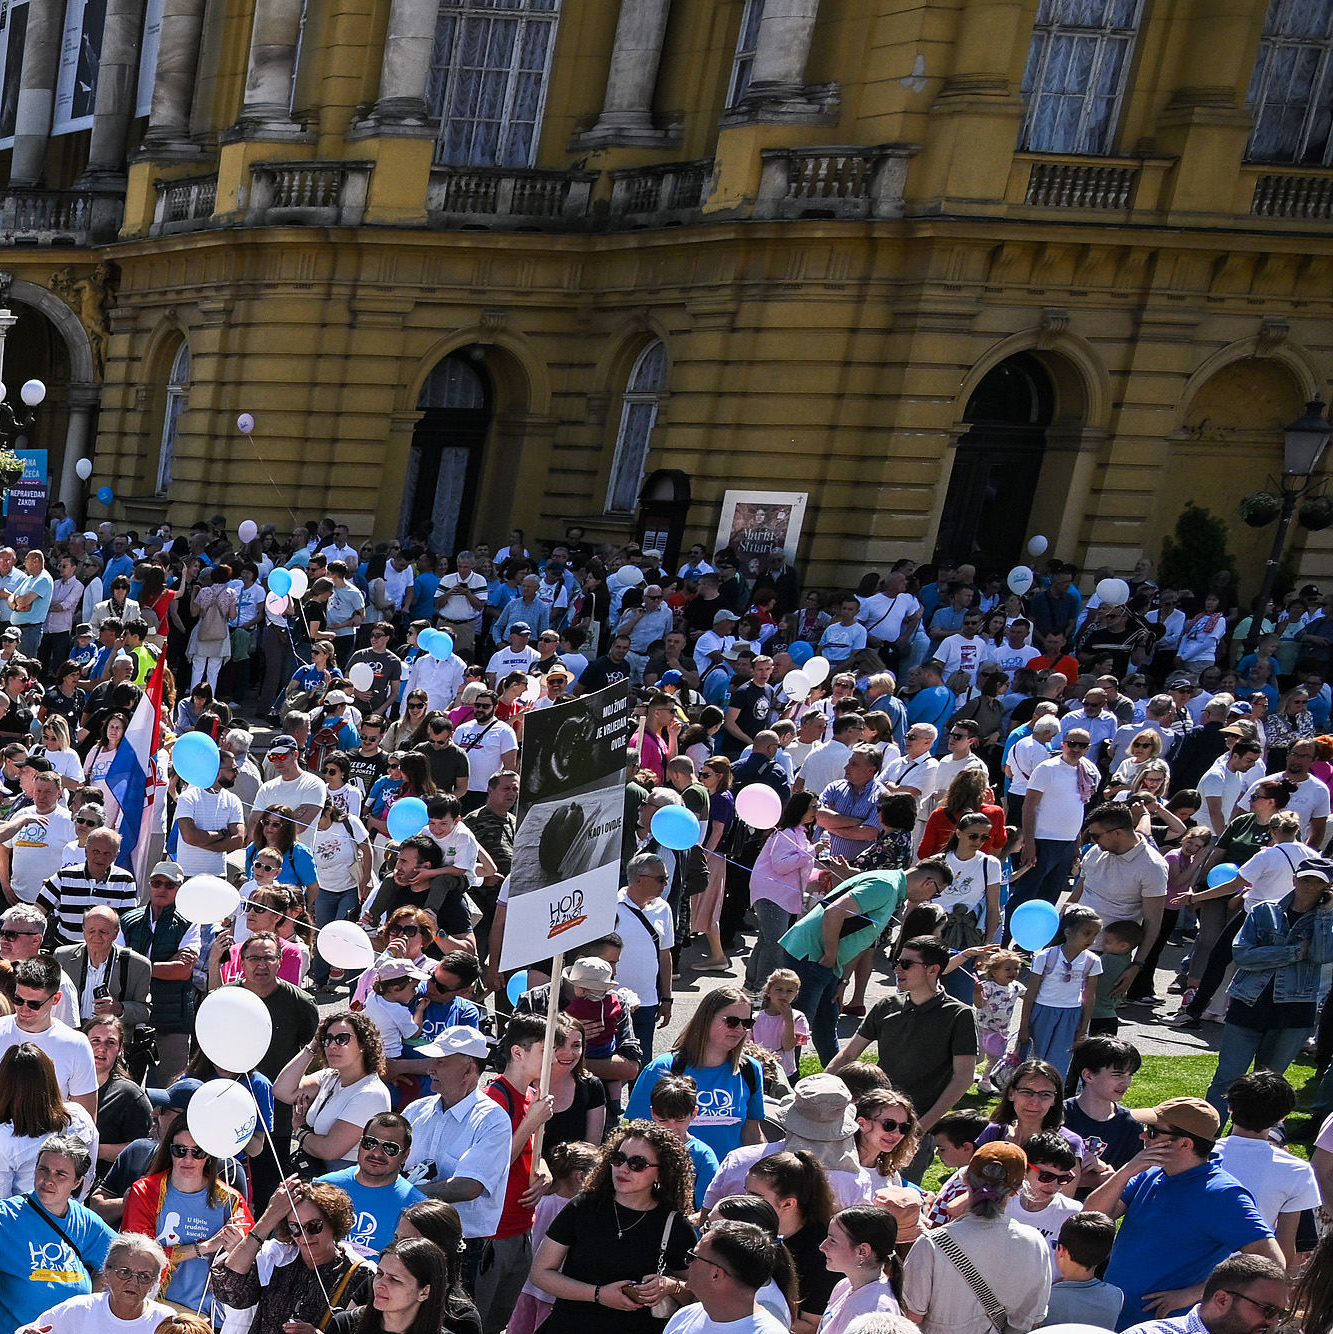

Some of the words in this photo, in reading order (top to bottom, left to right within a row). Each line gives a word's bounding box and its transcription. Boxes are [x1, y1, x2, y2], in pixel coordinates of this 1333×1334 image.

[10, 489, 46, 498] NEPRAVEDAN
[602, 702, 614, 719] MOJ
[604, 717, 627, 737] VRIJEDAN
[610, 735, 627, 752] OVDJE
[587, 824, 601, 840] KAO
[605, 817, 622, 835] OVDJE
[549, 889, 584, 921] HOD
[562, 906, 583, 923] ŽIVOT
[193, 1217, 208, 1226] tijelu
